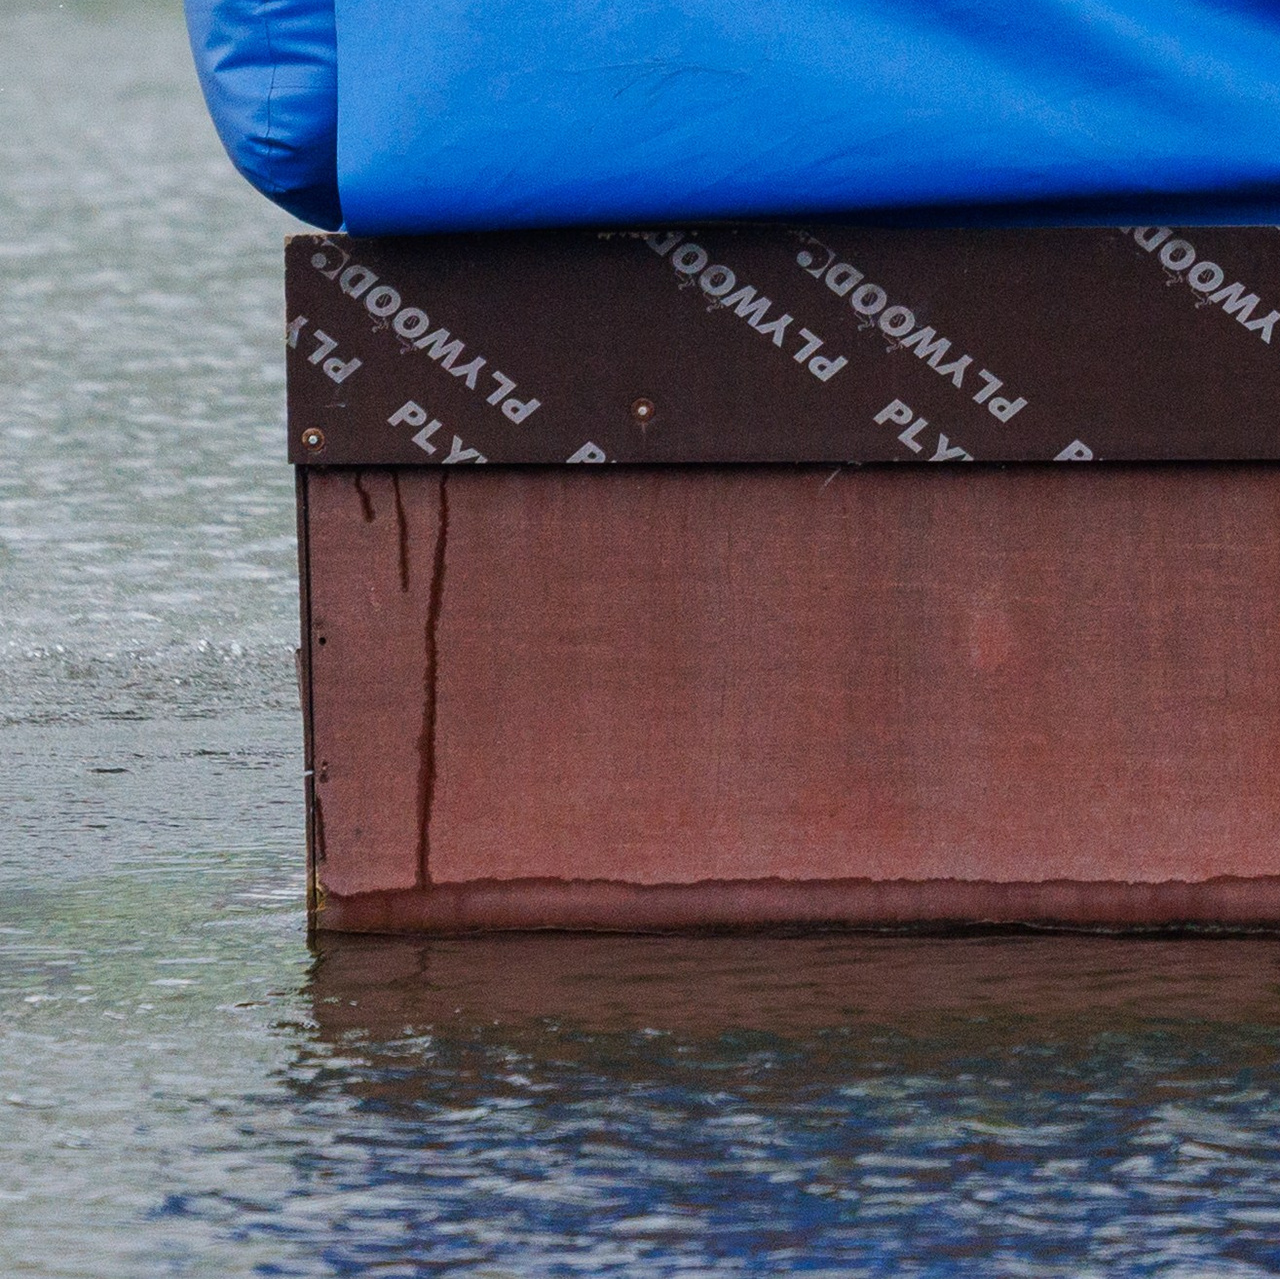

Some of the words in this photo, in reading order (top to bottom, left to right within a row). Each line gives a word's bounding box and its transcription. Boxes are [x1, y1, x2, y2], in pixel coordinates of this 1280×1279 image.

[340, 264, 541, 425] PLYWOOD
[825, 262, 1028, 423] PLYWOOD
[387, 400, 488, 464] PLY
[873, 398, 973, 461] PLY
